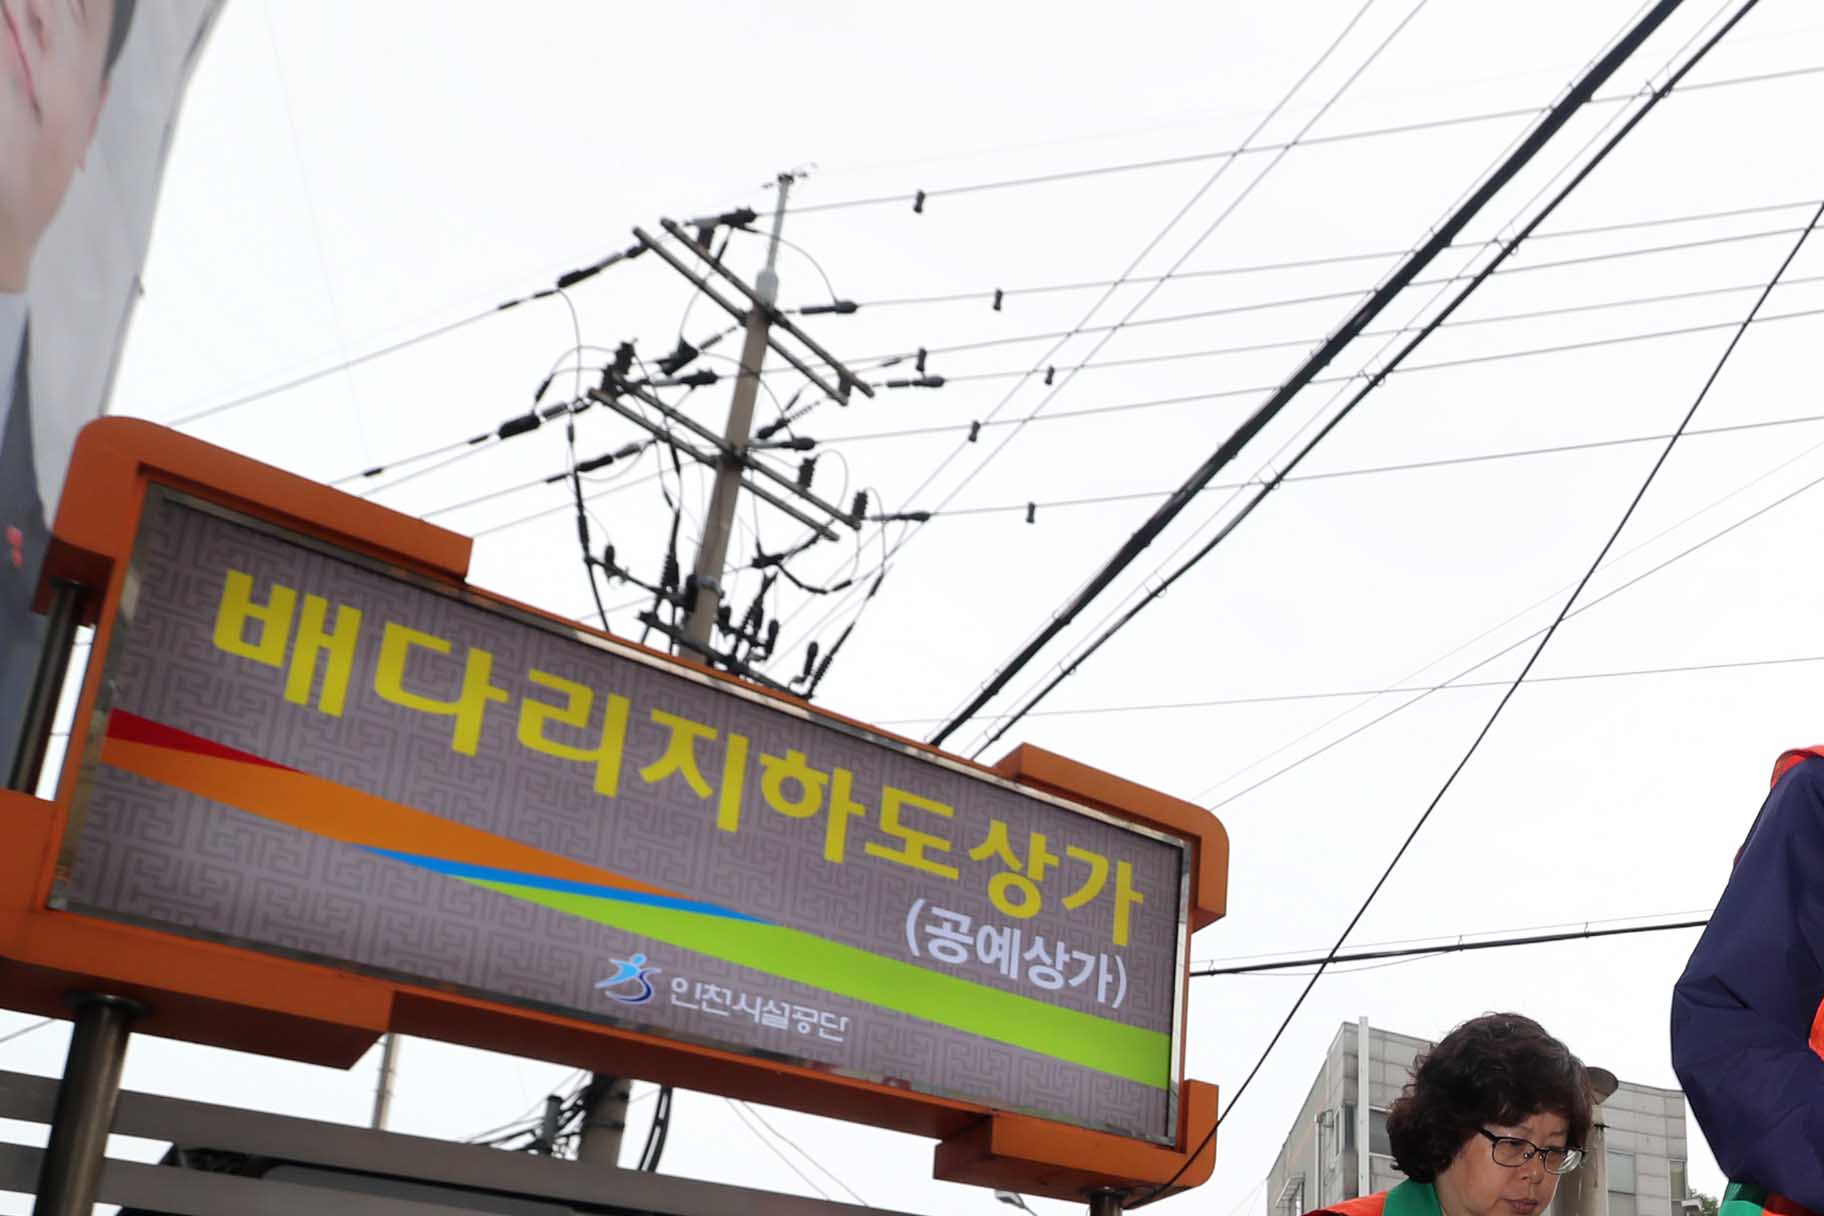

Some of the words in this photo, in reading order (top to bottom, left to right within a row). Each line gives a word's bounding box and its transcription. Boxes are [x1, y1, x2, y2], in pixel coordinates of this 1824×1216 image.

[212, 569, 1145, 946] 배다리지하도상가
[906, 898, 1128, 1008] (공예상가)
[671, 976, 848, 1042] 인천시설공단
